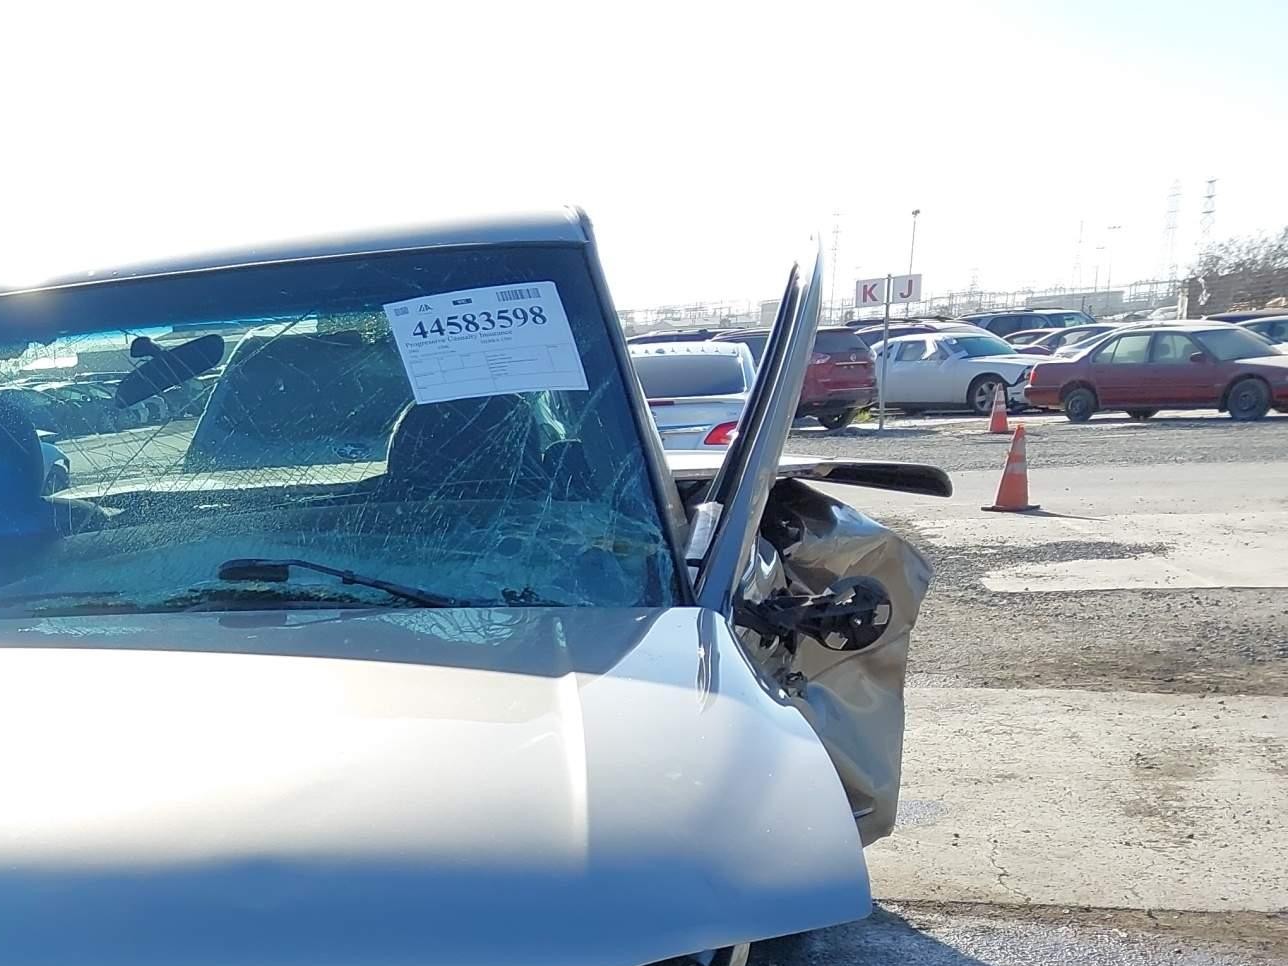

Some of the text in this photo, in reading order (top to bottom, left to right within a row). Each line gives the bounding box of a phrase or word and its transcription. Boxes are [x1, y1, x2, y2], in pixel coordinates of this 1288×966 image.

[862, 283, 878, 303] K
[899, 279, 913, 299] J
[412, 305, 547, 338] 44583598
